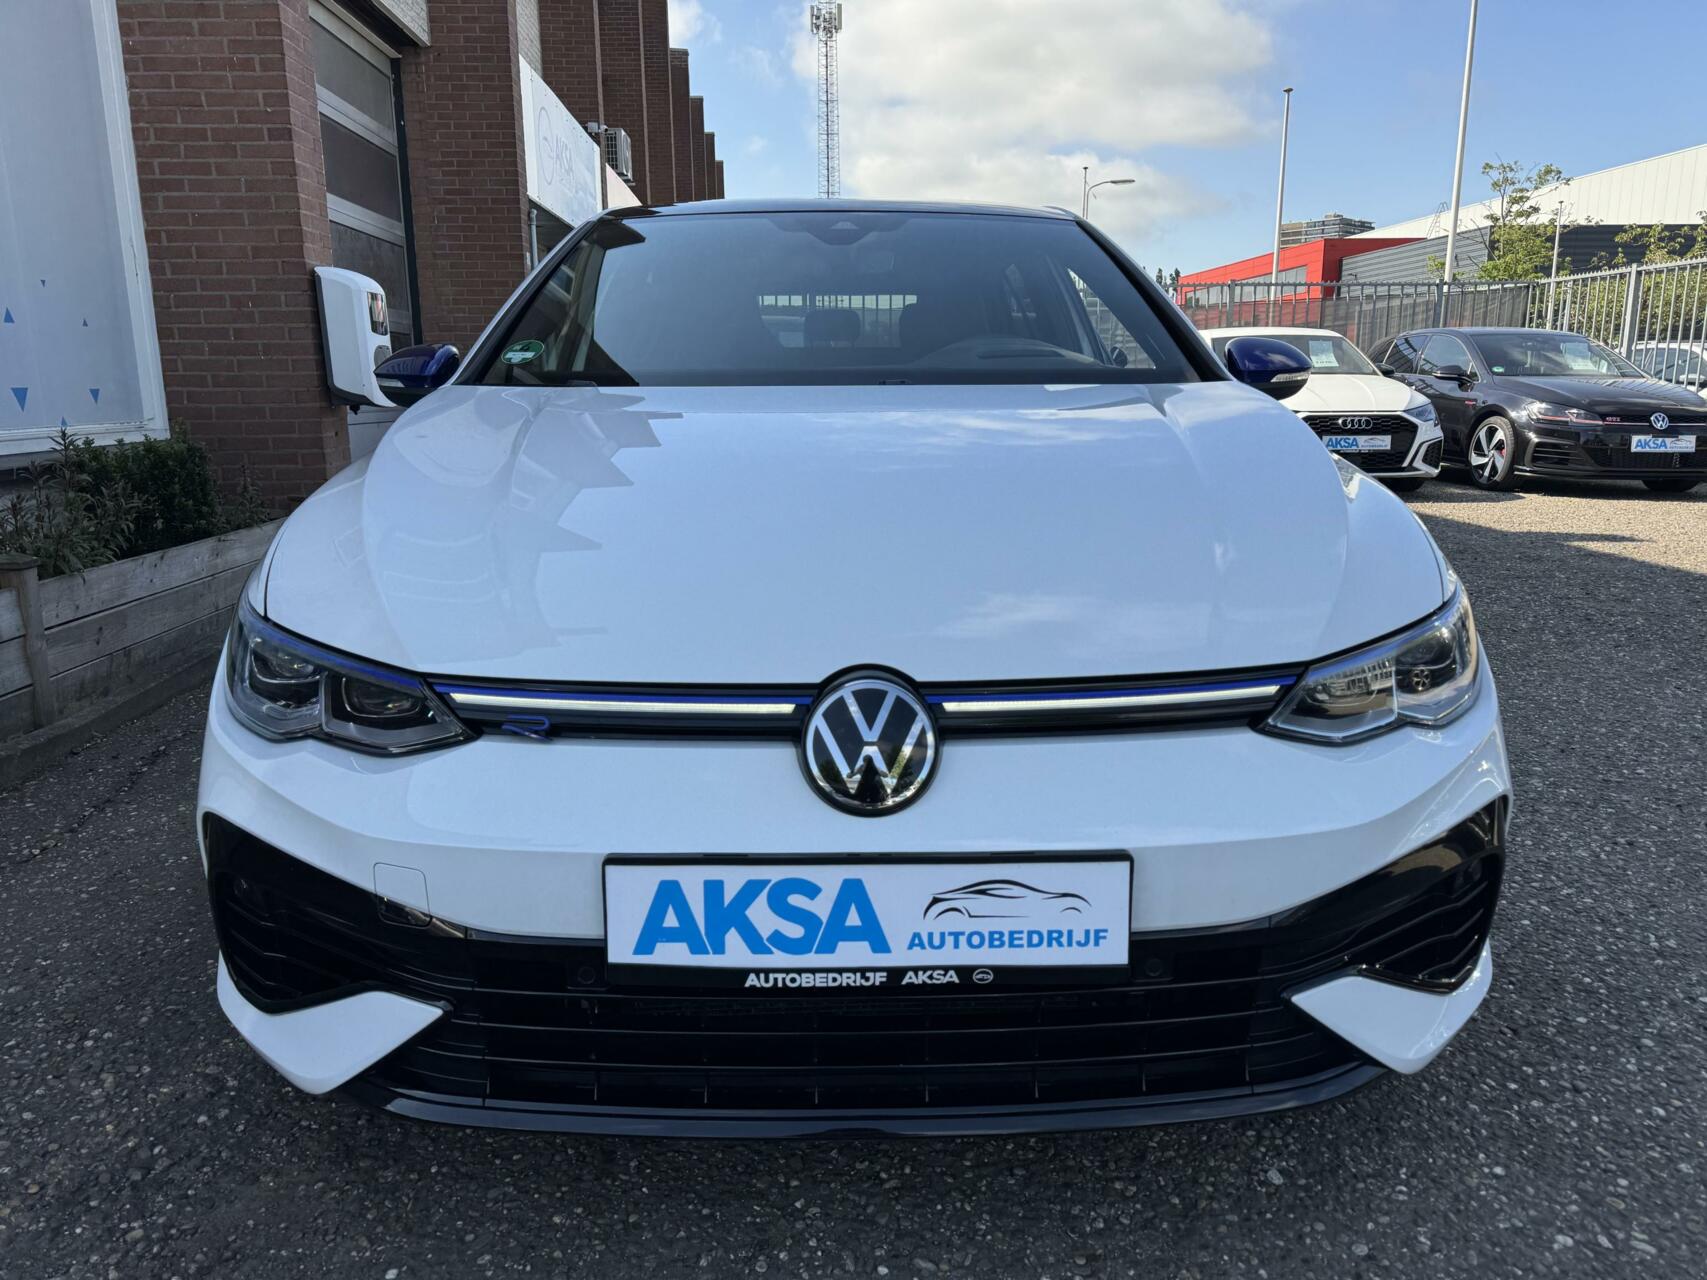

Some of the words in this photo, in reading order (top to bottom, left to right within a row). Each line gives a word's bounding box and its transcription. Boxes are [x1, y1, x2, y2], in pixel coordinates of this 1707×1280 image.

[1326, 437, 1359, 449] AKSA
[1634, 438, 1668, 450] AKSA
[632, 878, 892, 956] AKSA
[907, 928, 1109, 951] AUTOBEDRIJF
[744, 971, 888, 988] AUTOBEDRIJF
[901, 970, 960, 985] AKSA
